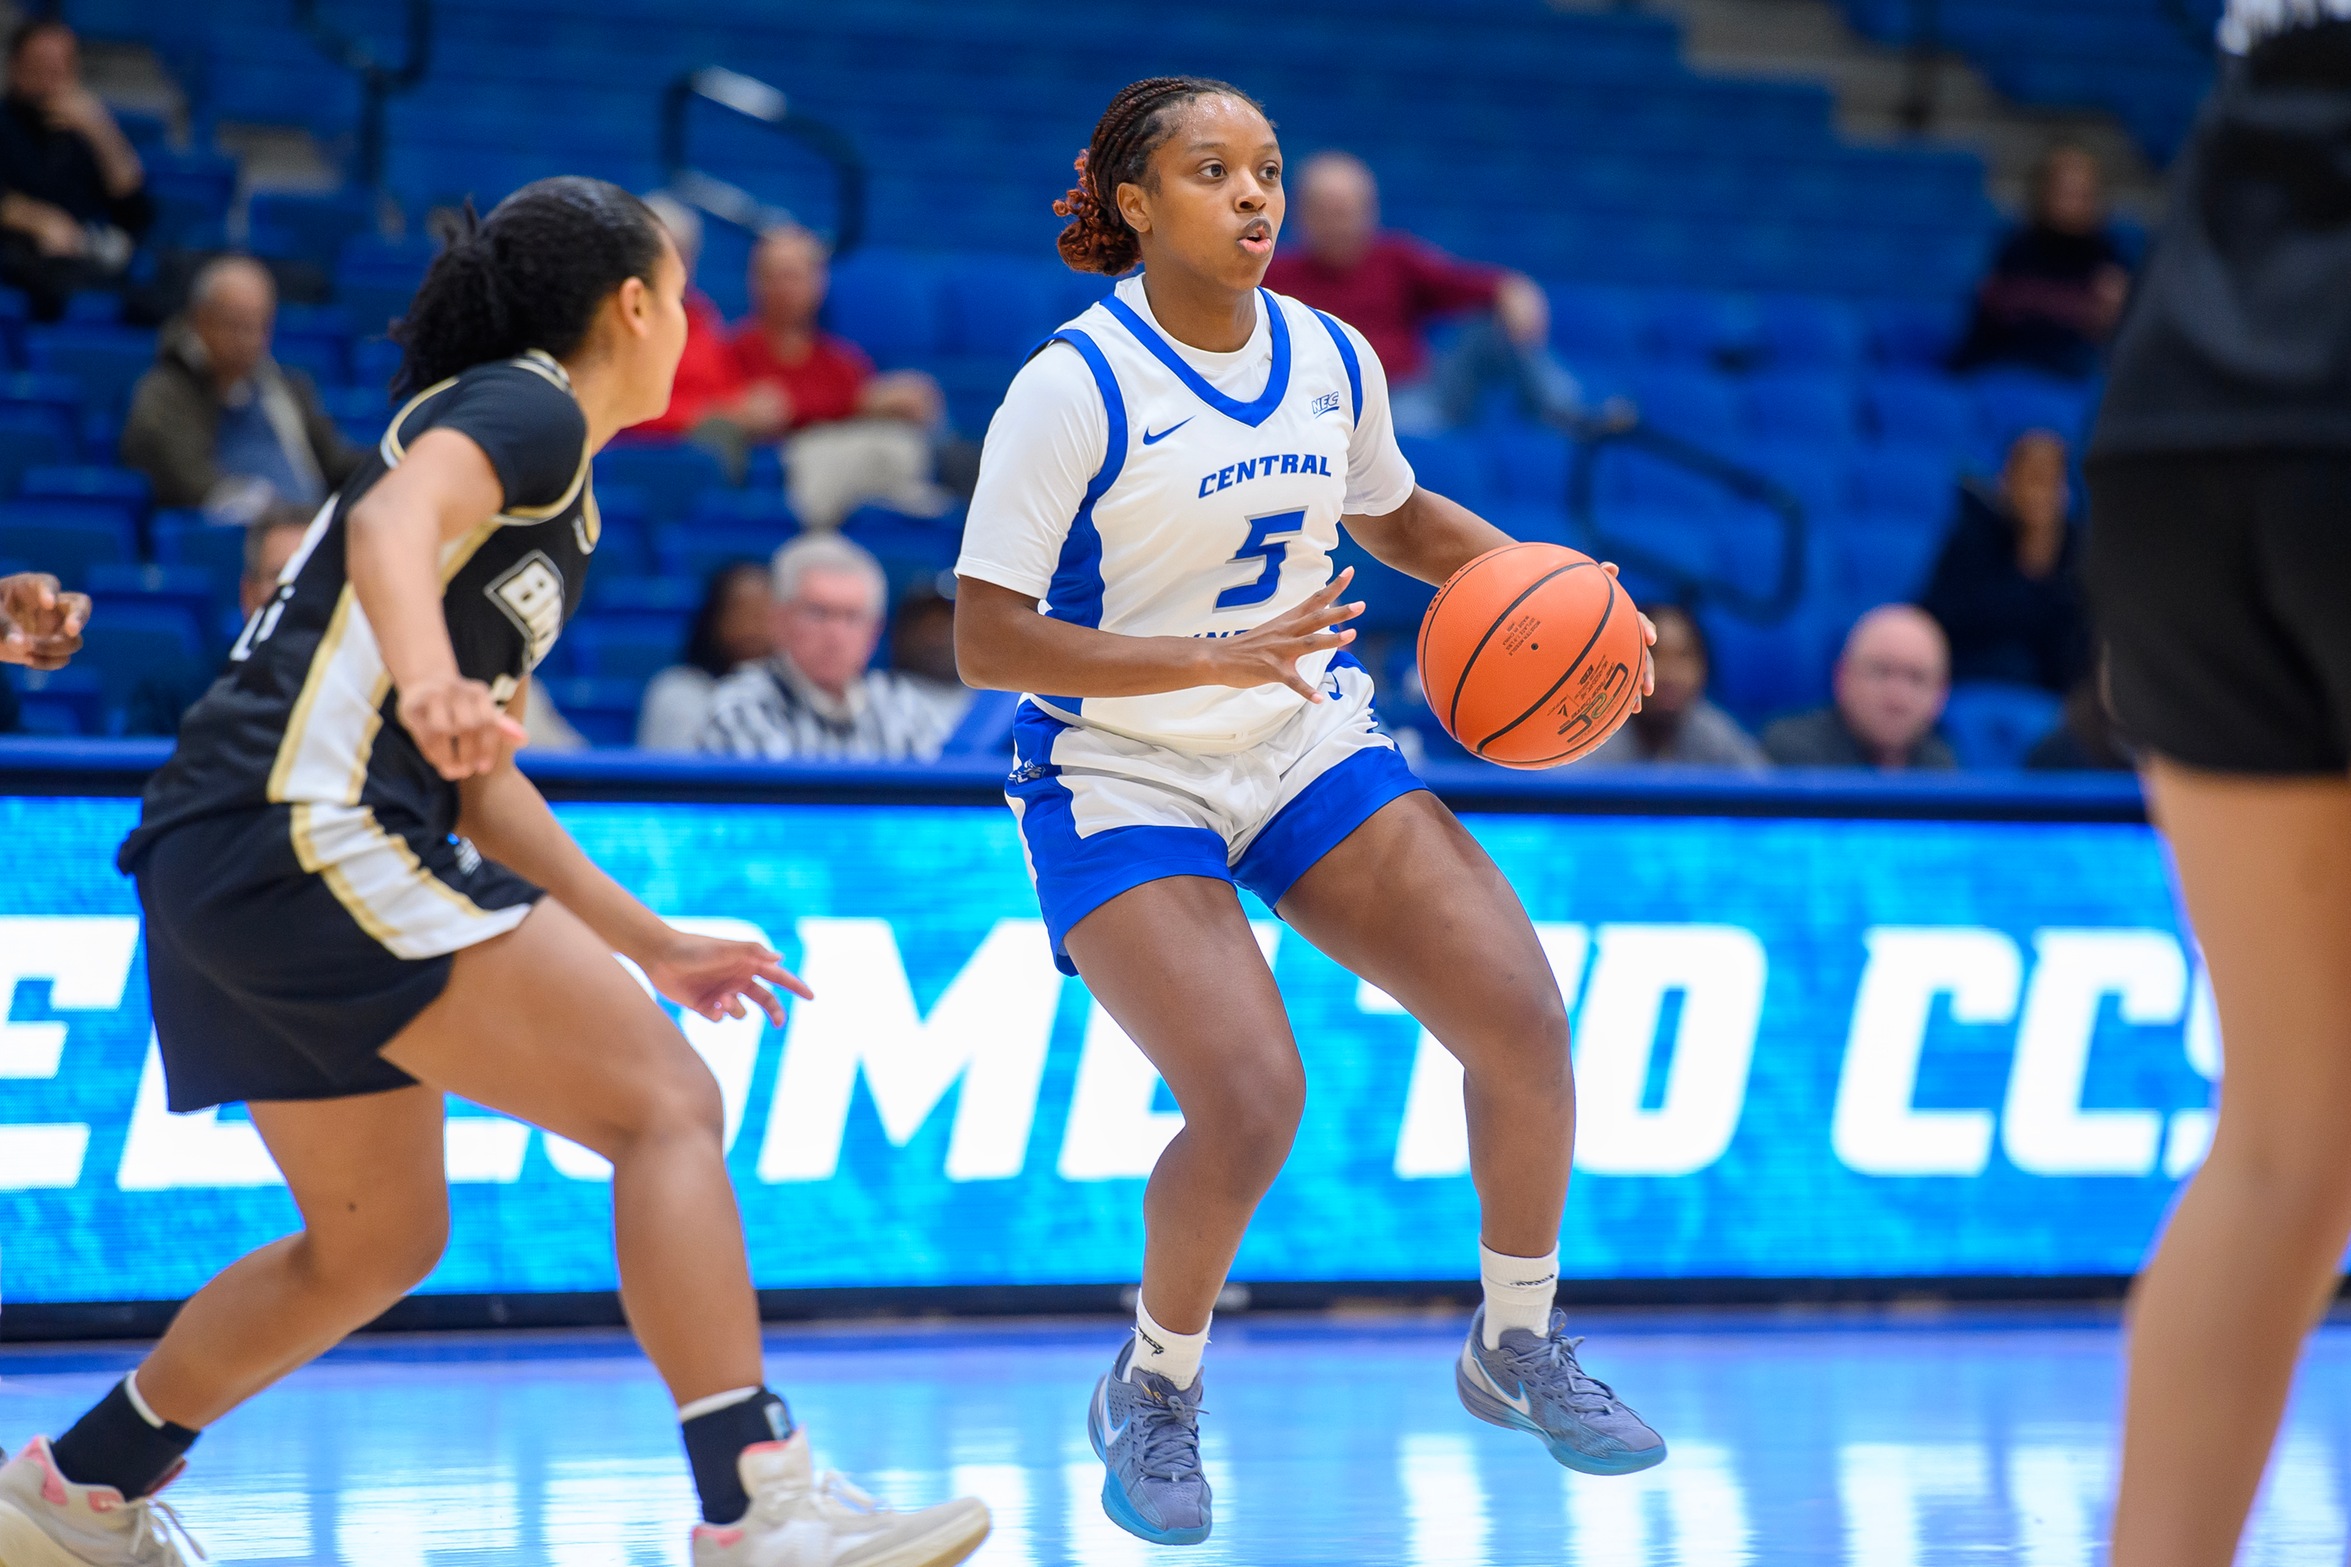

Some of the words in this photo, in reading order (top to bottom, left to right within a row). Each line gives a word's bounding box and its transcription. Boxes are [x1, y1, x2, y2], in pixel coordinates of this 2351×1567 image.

[1198, 453, 1332, 499] CENTRAL
[1212, 505, 1309, 613] 5
[1356, 921, 1768, 1178] TO
[1831, 925, 2224, 1180] CC
